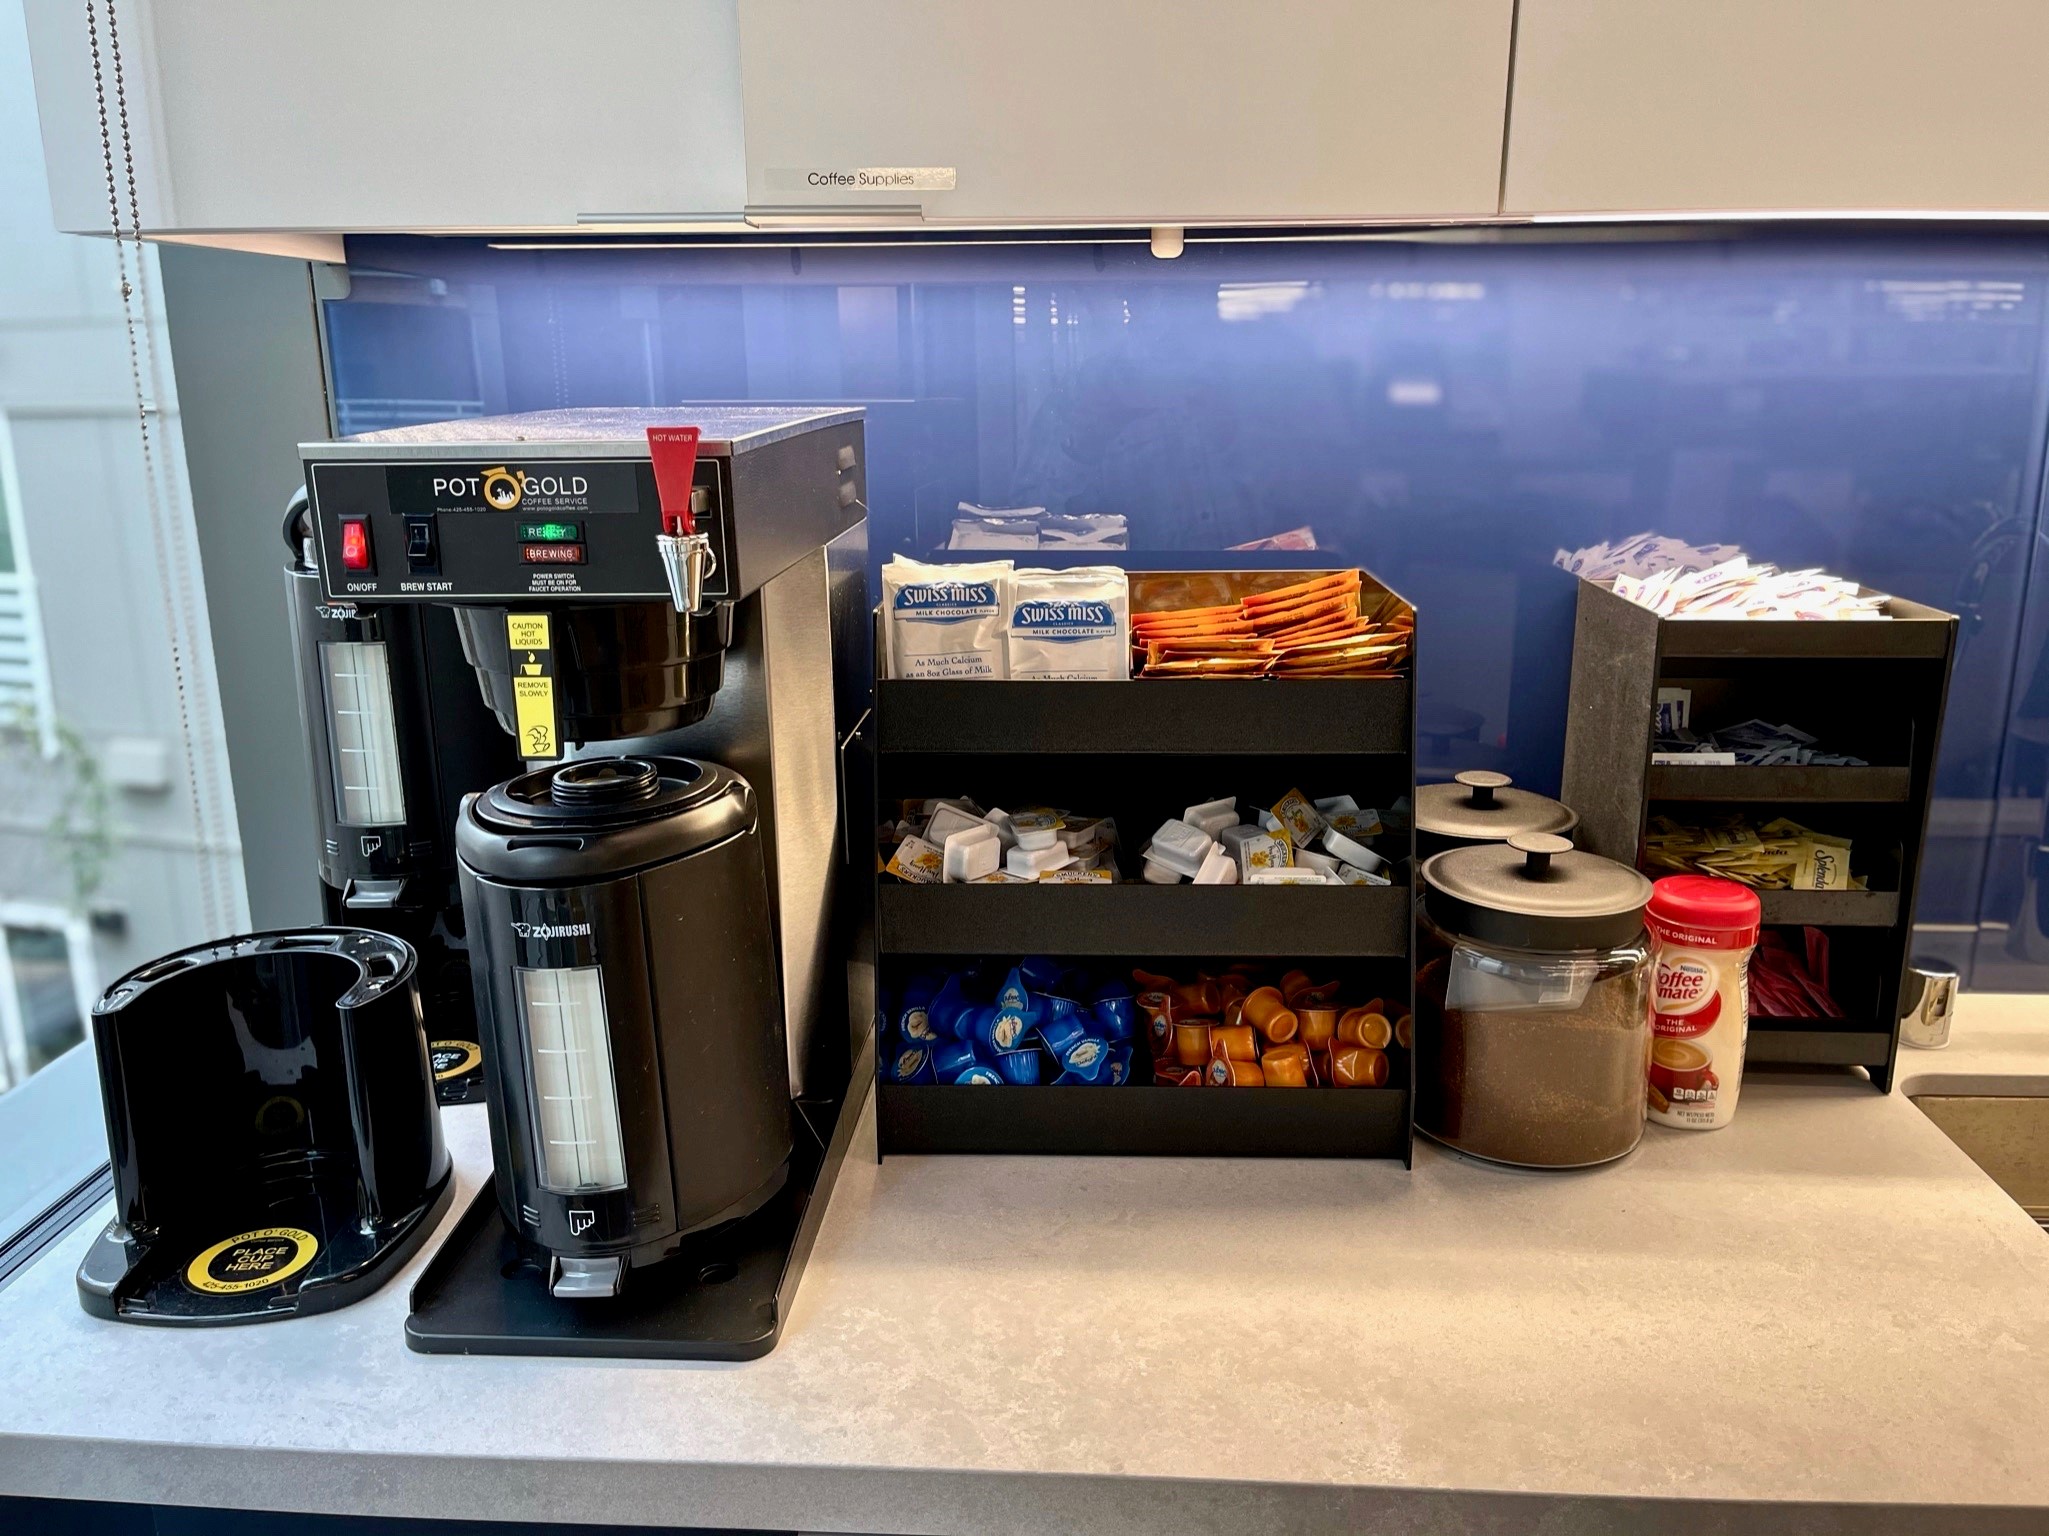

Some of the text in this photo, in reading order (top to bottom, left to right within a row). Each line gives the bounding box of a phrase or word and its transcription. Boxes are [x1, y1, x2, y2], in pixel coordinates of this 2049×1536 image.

[808, 172, 914, 186] Coffee Supplies
[652, 434, 693, 443] HOT WATER
[433, 478, 479, 497] POT
[523, 476, 588, 496] GOLD
[522, 497, 588, 506] COFFEE SERVICE
[528, 527, 567, 538] REY
[529, 548, 573, 559] BREWING
[346, 583, 377, 592] ON/OFF
[400, 582, 453, 592] BREW START
[550, 585, 582, 593] OPERATION
[935, 608, 977, 616] CHOCOLATE
[512, 622, 543, 630] CAUTION
[515, 638, 543, 646] LIQUIDS
[915, 655, 983, 667] As Much Calcium
[942, 667, 963, 677] Glass
[964, 666, 973, 675] of
[974, 665, 992, 674] Milk
[518, 681, 548, 689] REMOVE
[1813, 849, 1835, 889] Splenda
[532, 923, 592, 941] ZOJIRUSHI
[1657, 925, 1717, 945] THE ORIGINAL
[1657, 970, 1704, 988] offee
[1656, 988, 1699, 1000] mate
[1666, 1018, 1685, 1026] THE
[1655, 1024, 1697, 1033] ORIGINAL
[231, 1231, 260, 1245] POT
[279, 1228, 309, 1242] GOLD
[232, 1246, 289, 1257] PLACE
[237, 1254, 274, 1263] CUP
[225, 1261, 274, 1272] HERE
